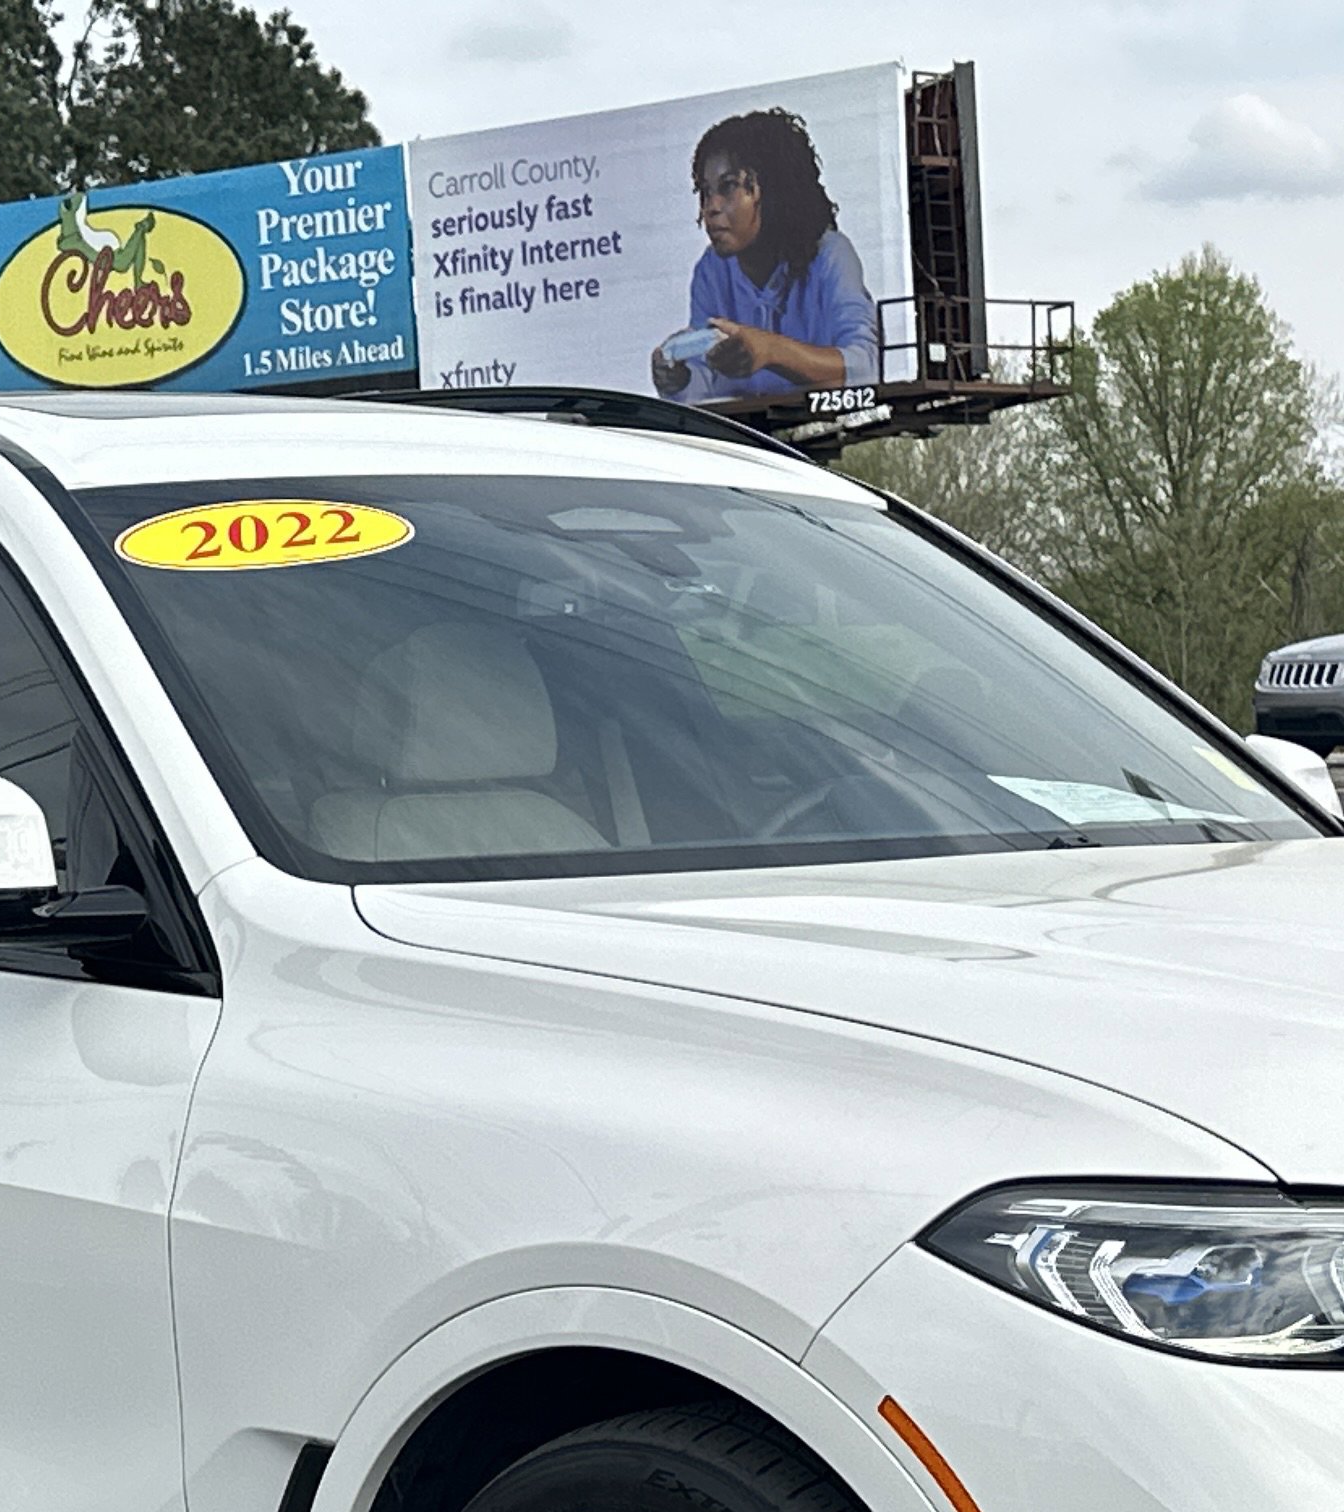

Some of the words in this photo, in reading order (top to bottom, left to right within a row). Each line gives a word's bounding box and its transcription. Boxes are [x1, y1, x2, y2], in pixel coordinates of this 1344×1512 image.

[278, 159, 364, 197] Your
[428, 162, 506, 199] Carroll
[511, 155, 600, 186] County,
[256, 197, 393, 246] Premier
[431, 200, 539, 239] seriously
[545, 194, 593, 222] fast
[259, 246, 396, 291] Package
[433, 244, 514, 279] Xfinity
[521, 230, 622, 266] Internet
[40, 245, 192, 337] Cheers
[280, 289, 378, 336] Store!
[435, 291, 454, 318] is
[459, 282, 536, 315] finally
[543, 278, 600, 303] here
[116, 339, 141, 356] and
[243, 350, 273, 377] 1.5
[275, 345, 333, 374] Miles
[335, 335, 405, 366] Ahead
[439, 359, 517, 390] xfinity
[808, 387, 876, 413] 725612
[180, 509, 361, 561] 2022
